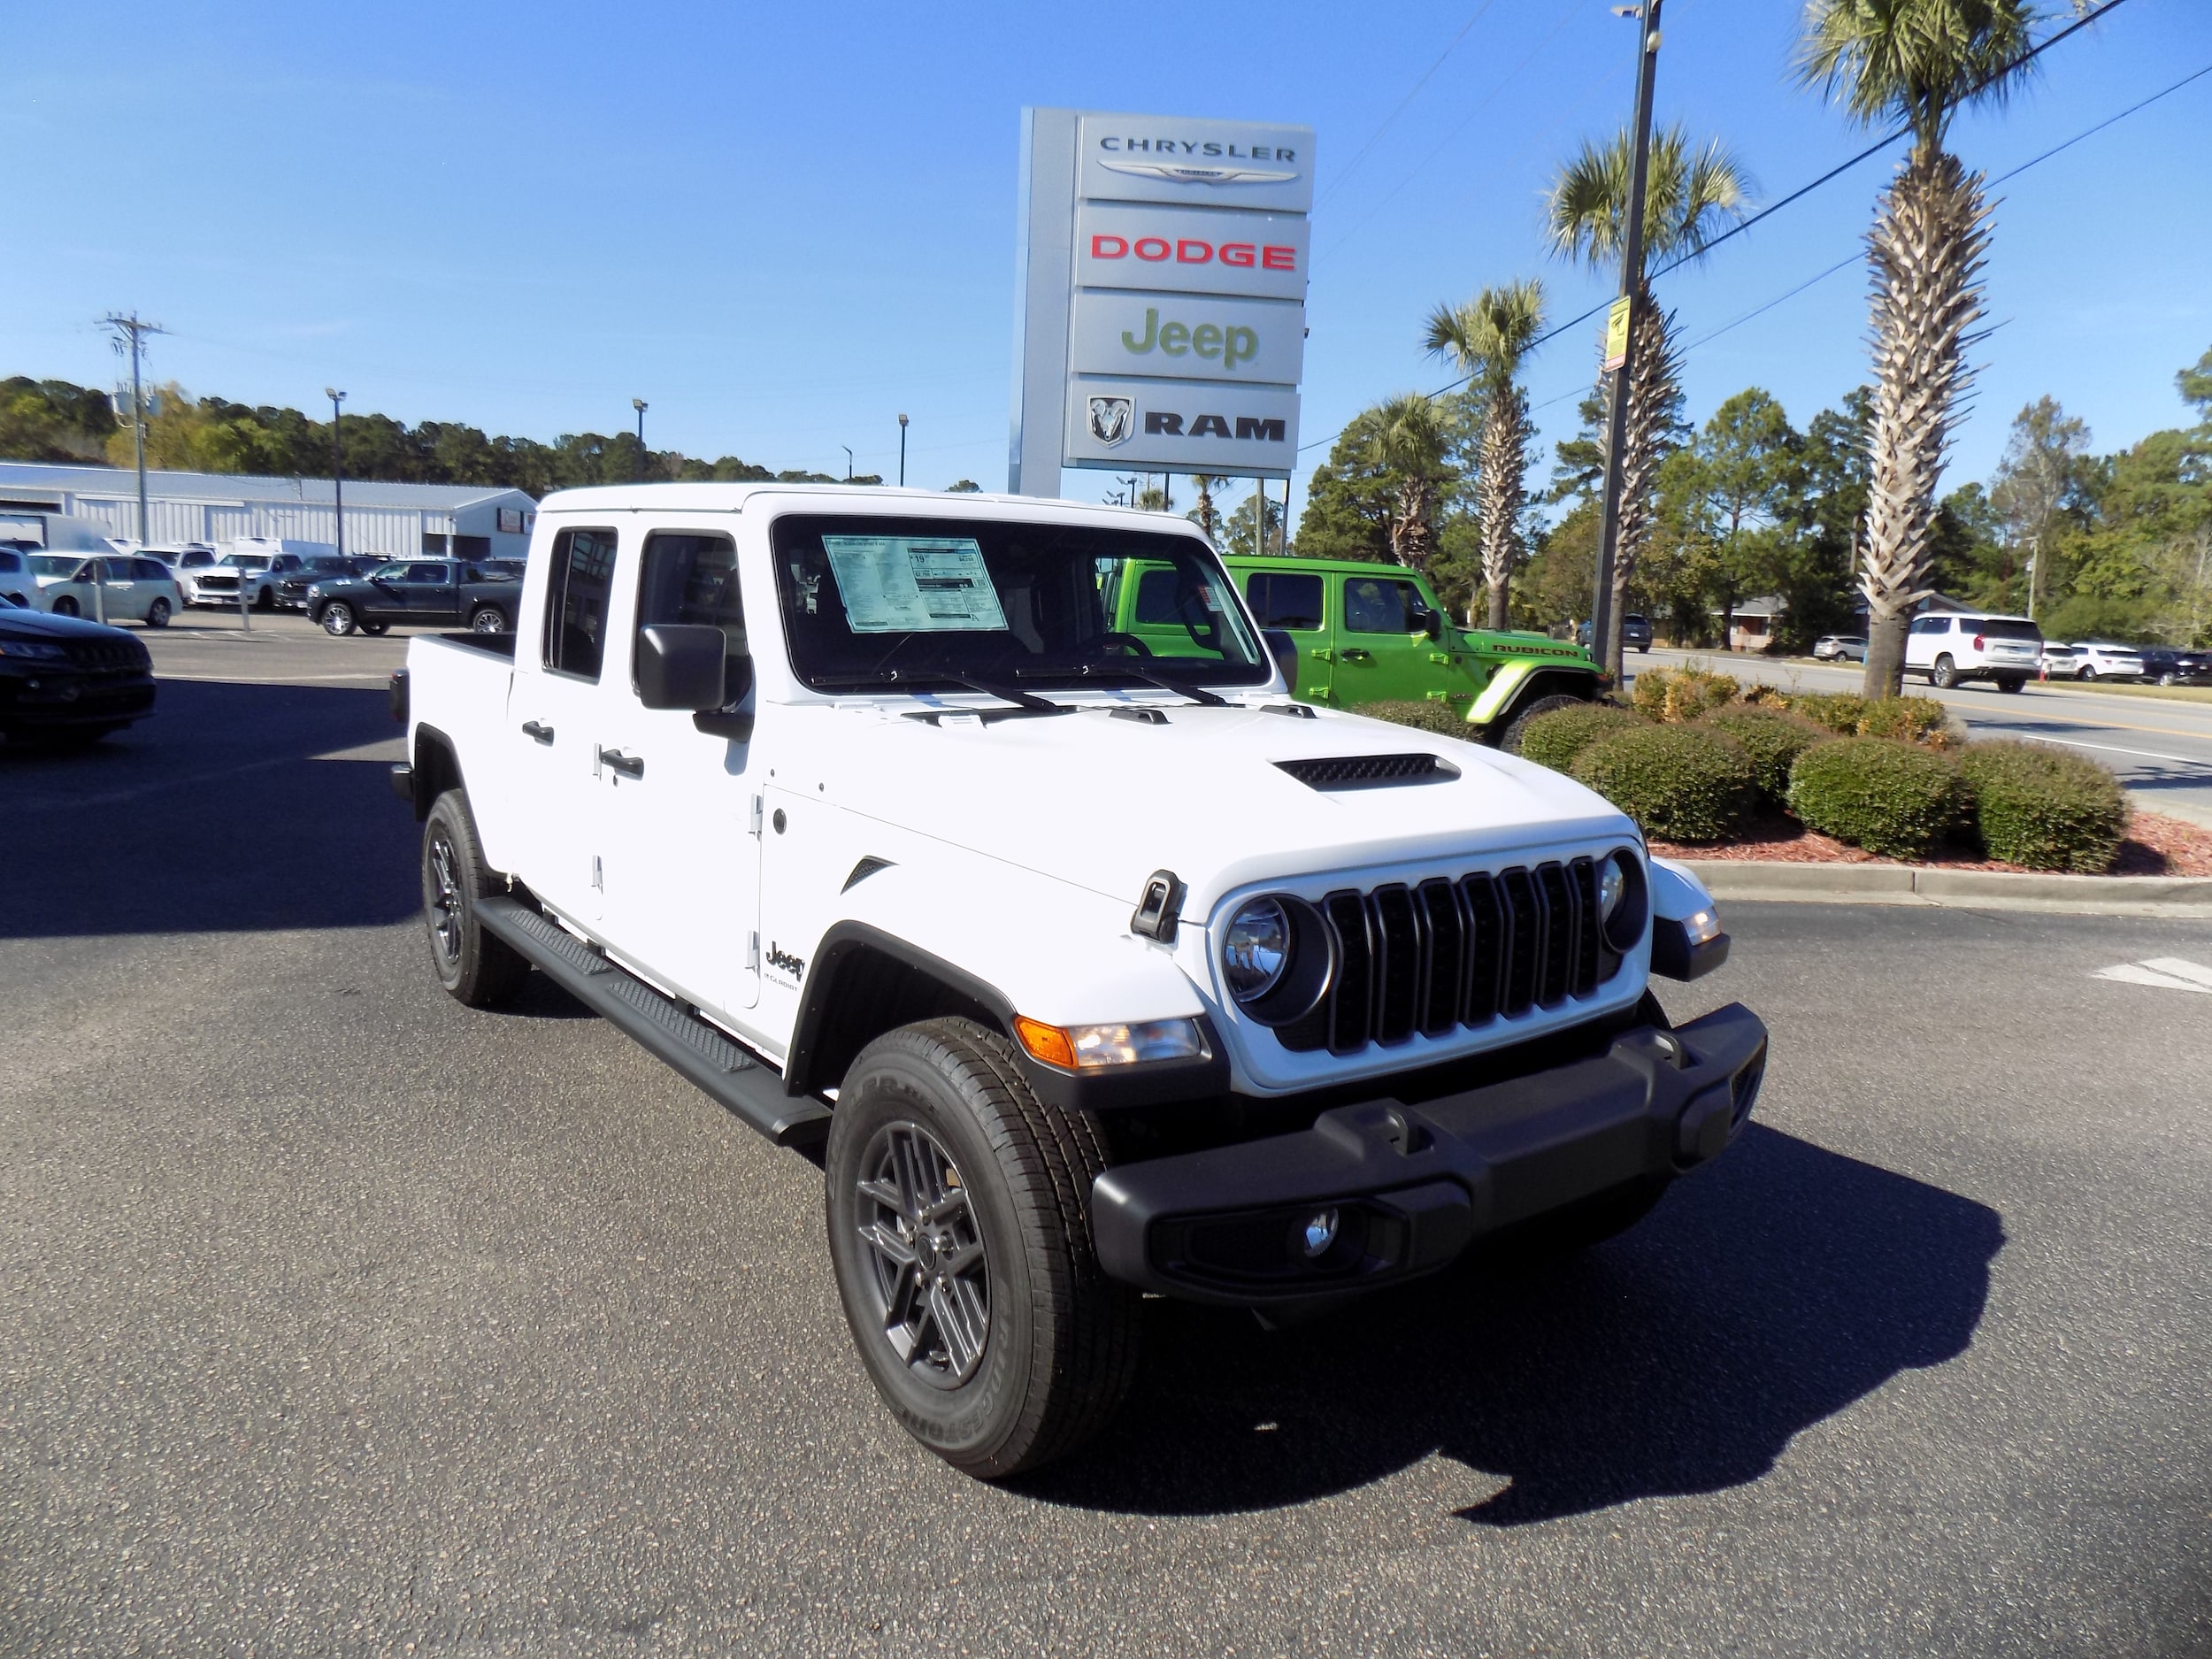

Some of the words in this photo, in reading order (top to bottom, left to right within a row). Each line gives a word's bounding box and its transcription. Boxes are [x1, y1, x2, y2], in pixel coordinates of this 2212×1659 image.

[1100, 137, 1295, 163] CHRYSLER
[1091, 234, 1296, 271] DODGE
[1121, 308, 1259, 370] Jeep
[1145, 411, 1286, 442] RAM
[1493, 644, 1578, 657] RUBICON
[765, 941, 806, 982] Jeep
